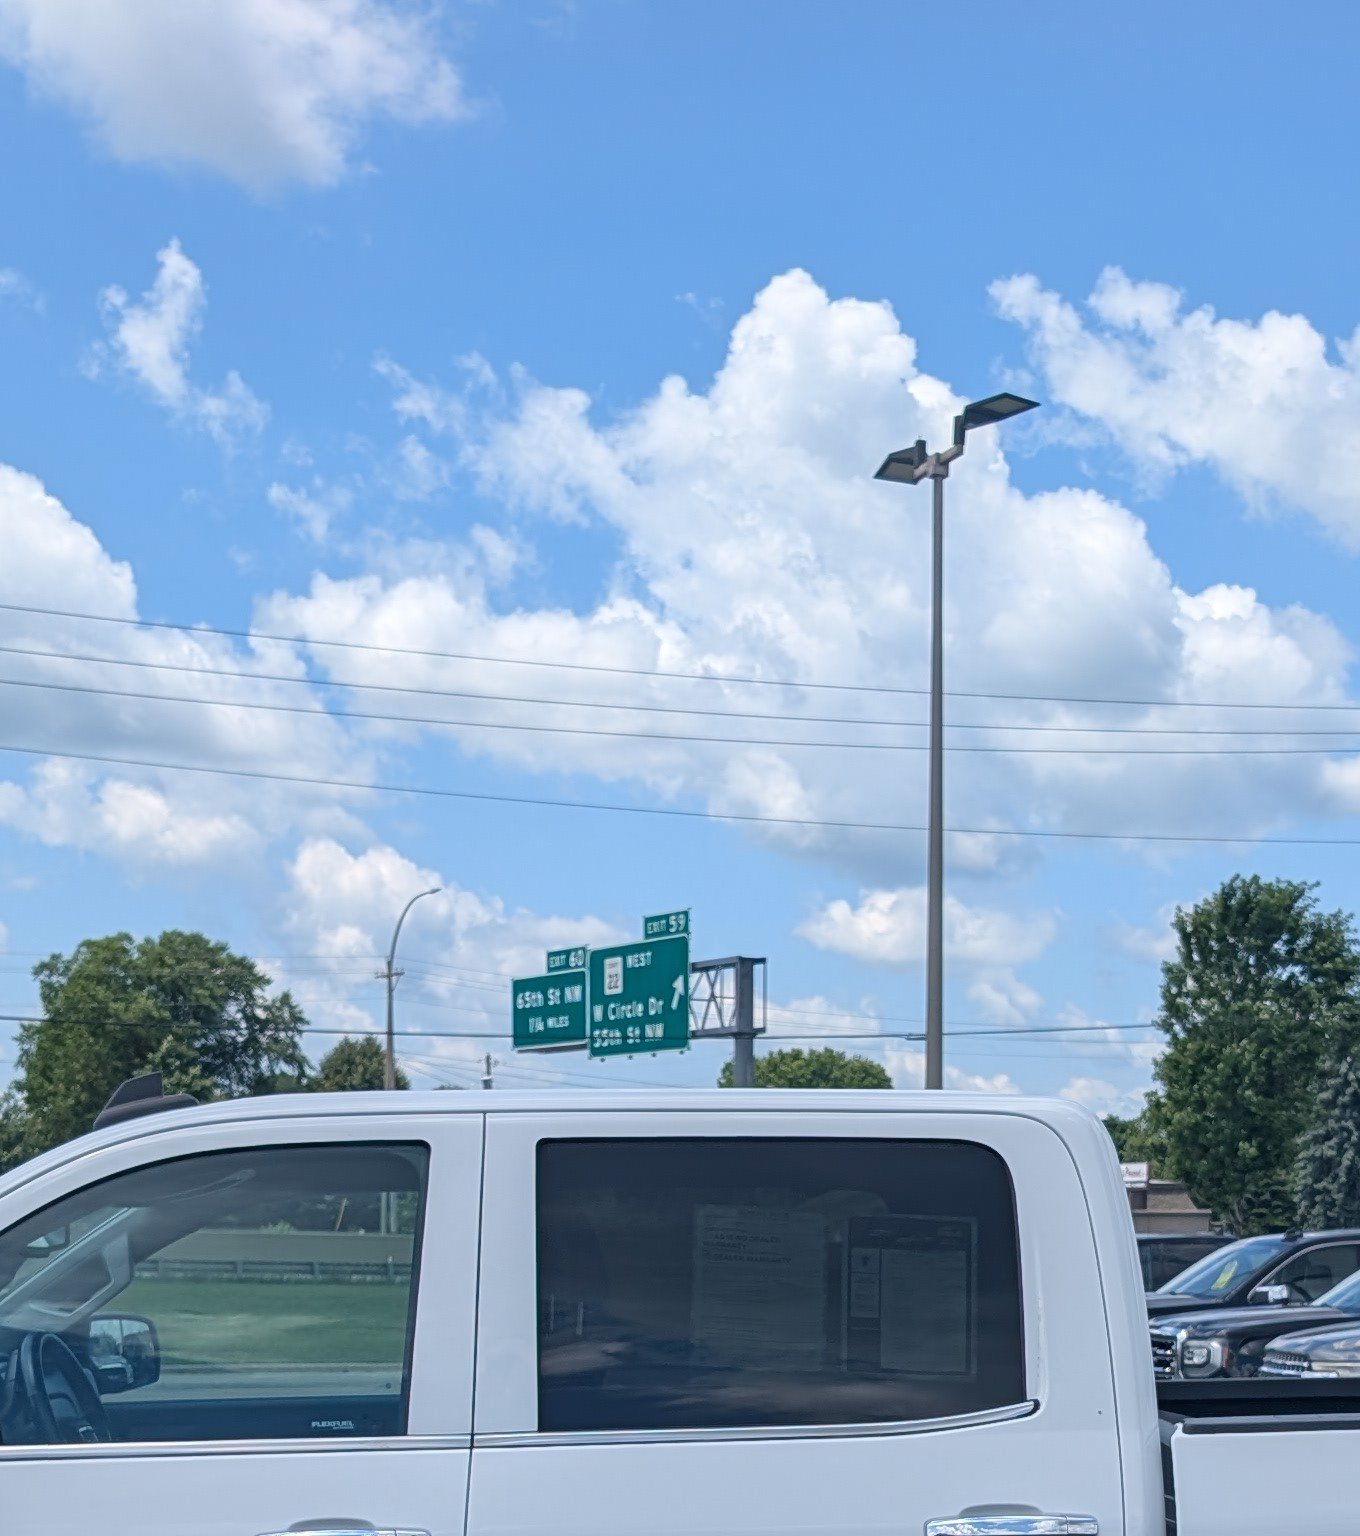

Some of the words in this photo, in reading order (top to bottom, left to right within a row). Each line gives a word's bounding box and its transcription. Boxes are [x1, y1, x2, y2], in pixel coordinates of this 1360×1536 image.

[668, 913, 687, 933] 59
[625, 951, 652, 969] WEST
[547, 987, 561, 1006] St
[564, 984, 583, 1004] NW
[592, 1004, 604, 1022] W
[607, 1000, 644, 1021] Circle
[648, 995, 665, 1016] Dr
[626, 1025, 641, 1045] St
